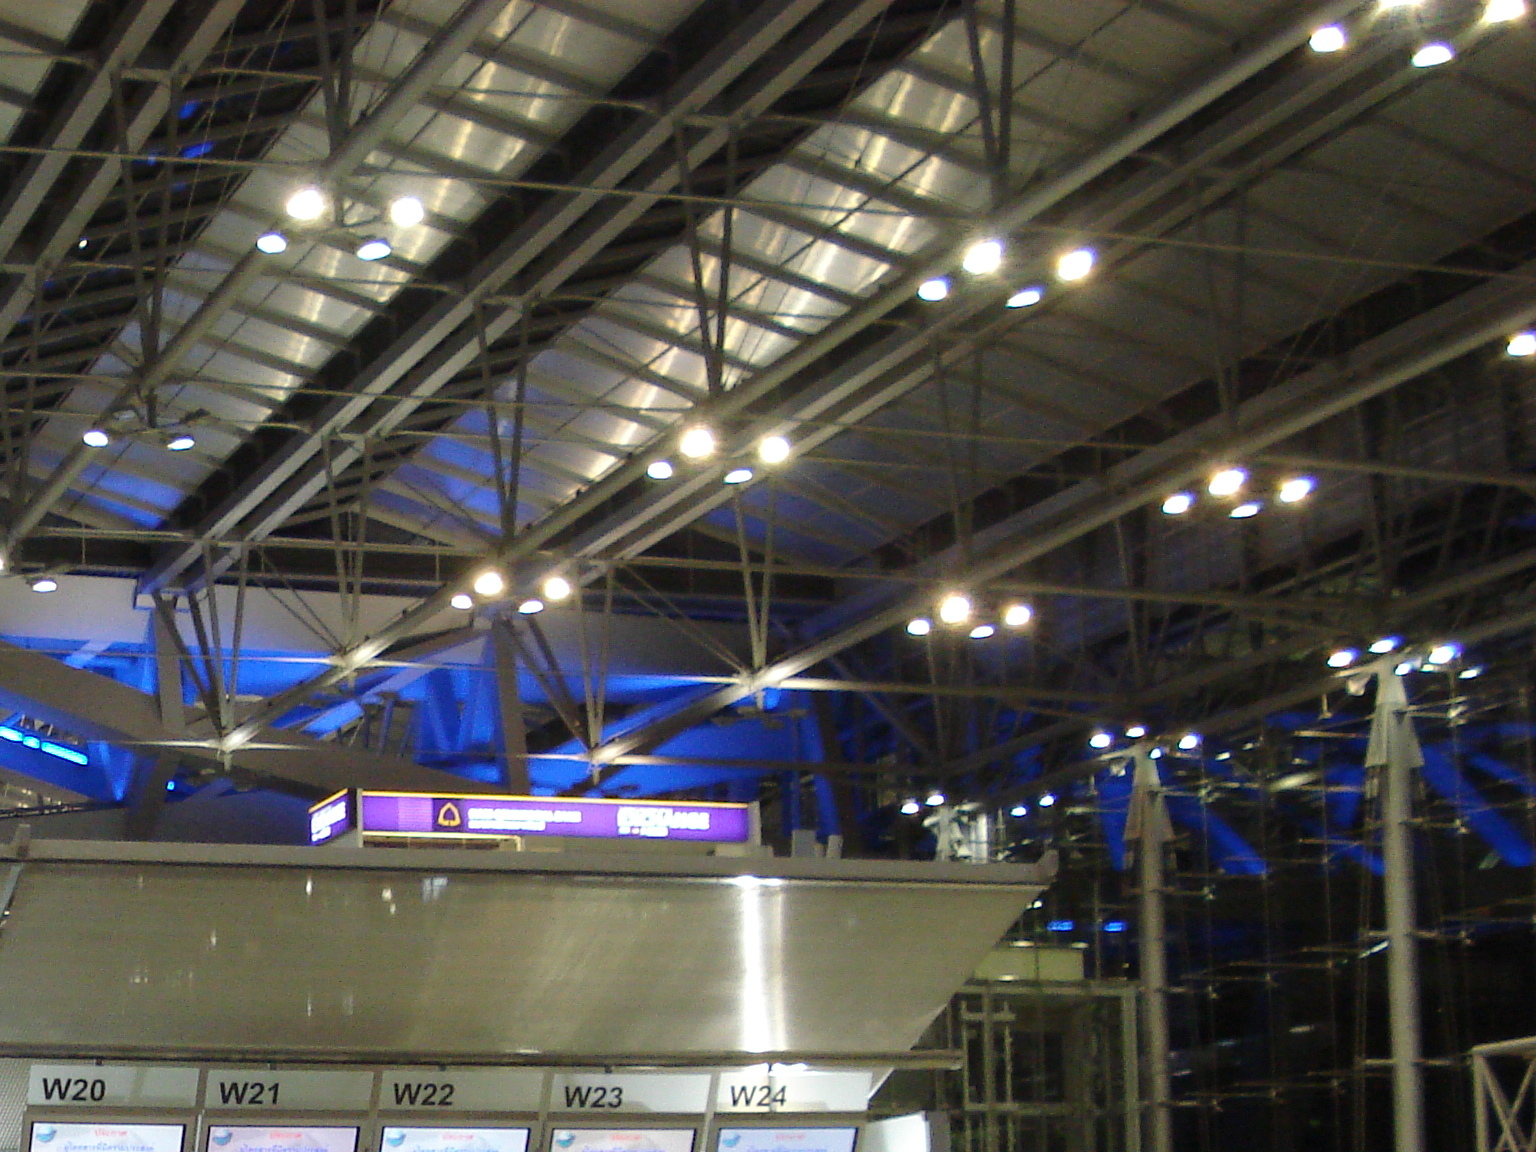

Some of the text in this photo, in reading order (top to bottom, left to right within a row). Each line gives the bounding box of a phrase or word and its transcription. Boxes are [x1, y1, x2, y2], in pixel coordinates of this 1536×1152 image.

[42, 1078, 106, 1101] W20
[219, 1082, 280, 1105] W21
[394, 1083, 455, 1106] W22
[565, 1086, 623, 1109] W23
[730, 1085, 787, 1107] W24
